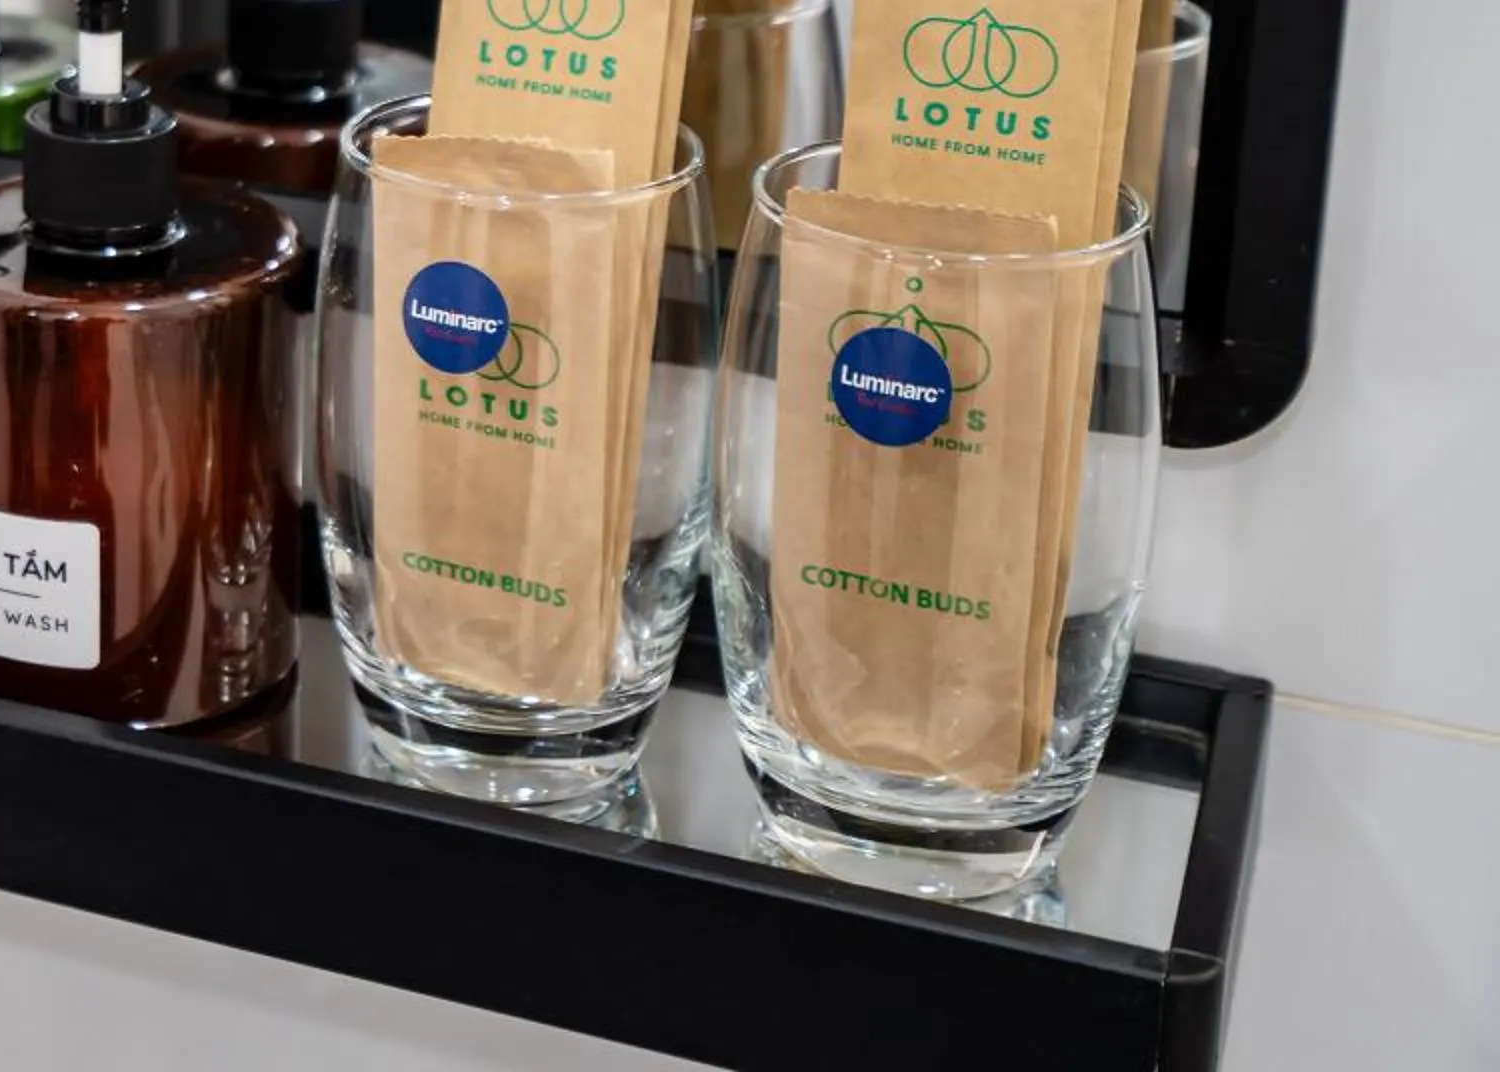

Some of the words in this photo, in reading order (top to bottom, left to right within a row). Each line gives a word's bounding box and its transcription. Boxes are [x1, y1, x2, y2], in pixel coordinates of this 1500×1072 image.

[479, 41, 617, 79] LOTUS
[476, 74, 517, 90] HOME
[524, 78, 563, 96] FROM
[570, 84, 612, 103] HOME
[894, 97, 1051, 140] LOTUS
[891, 134, 937, 150] HOME
[944, 140, 991, 157] FROM
[997, 148, 1045, 165] HOME
[419, 378, 558, 427] LOTUS
[419, 410, 461, 429] HOME
[3, 549, 68, 583] TẮM
[403, 552, 494, 588] COTTON
[501, 575, 567, 607] BUDS
[801, 565, 909, 605] COTTON
[916, 588, 991, 620] BUDS
[4, 609, 69, 634] WASH
